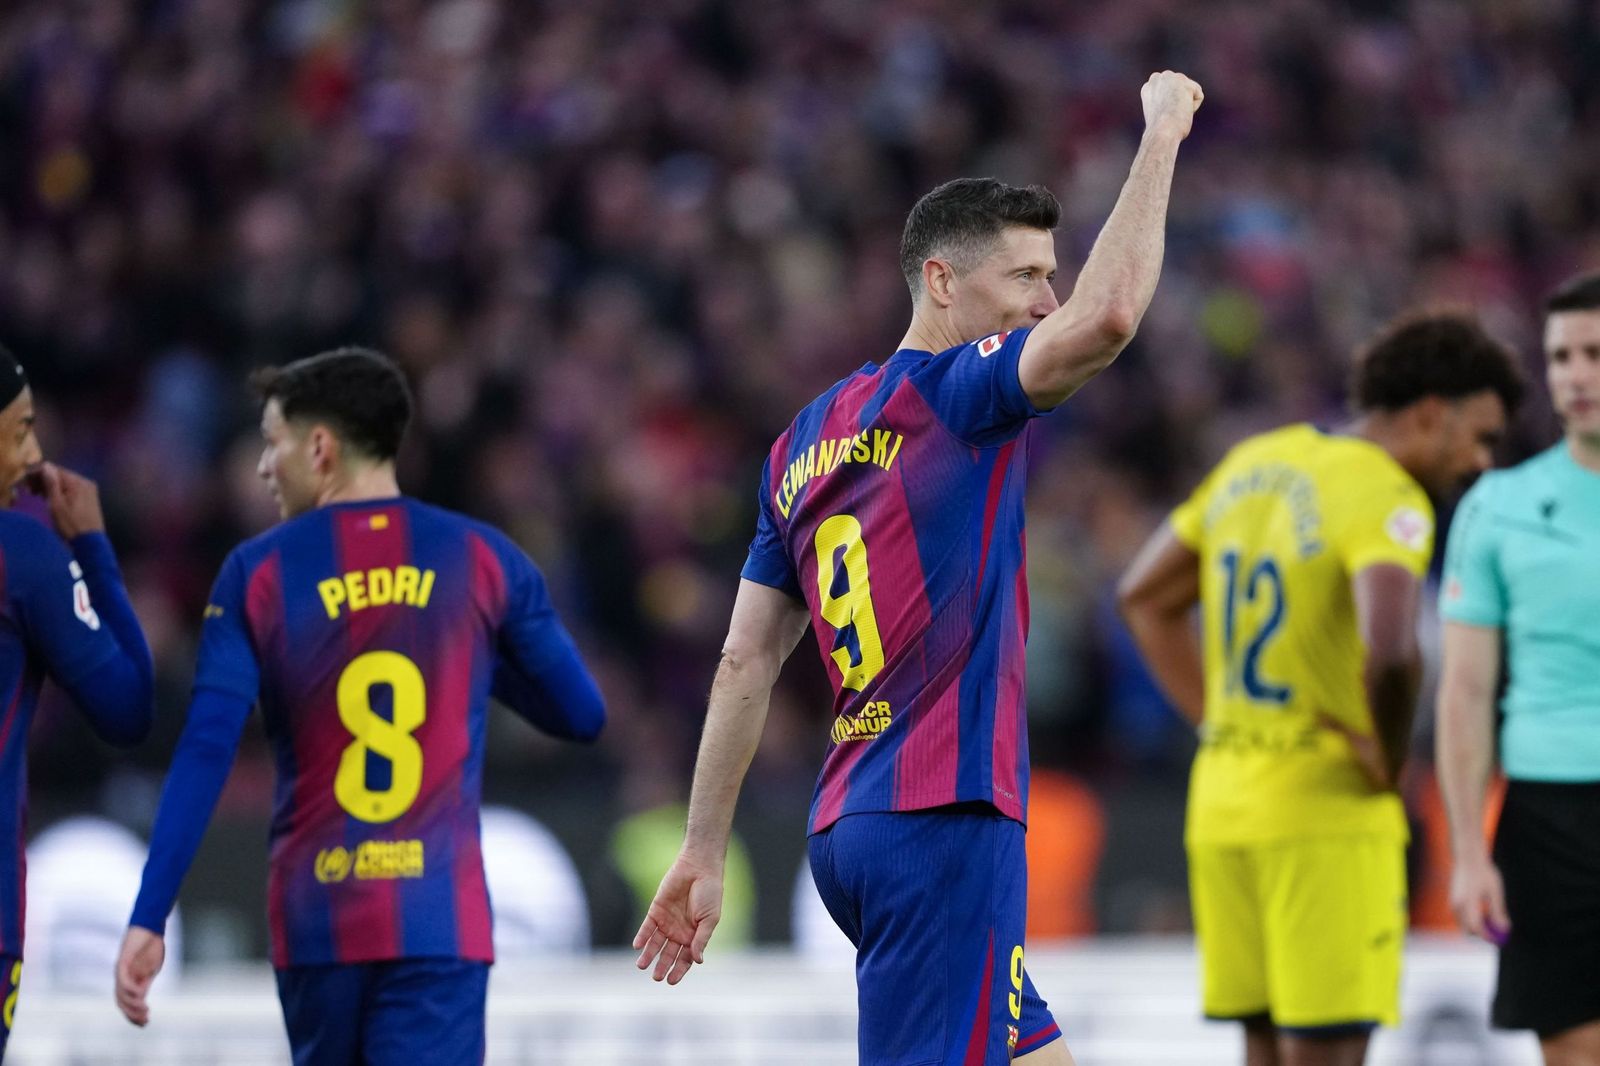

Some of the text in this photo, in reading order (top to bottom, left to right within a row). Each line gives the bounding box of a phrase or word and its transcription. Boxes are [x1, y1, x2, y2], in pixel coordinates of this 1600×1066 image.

[317, 564, 437, 620] PEDRI
[814, 514, 885, 692] 9
[1221, 552, 1291, 704] 12
[334, 650, 427, 824] 8
[1008, 945, 1024, 1020] 9
